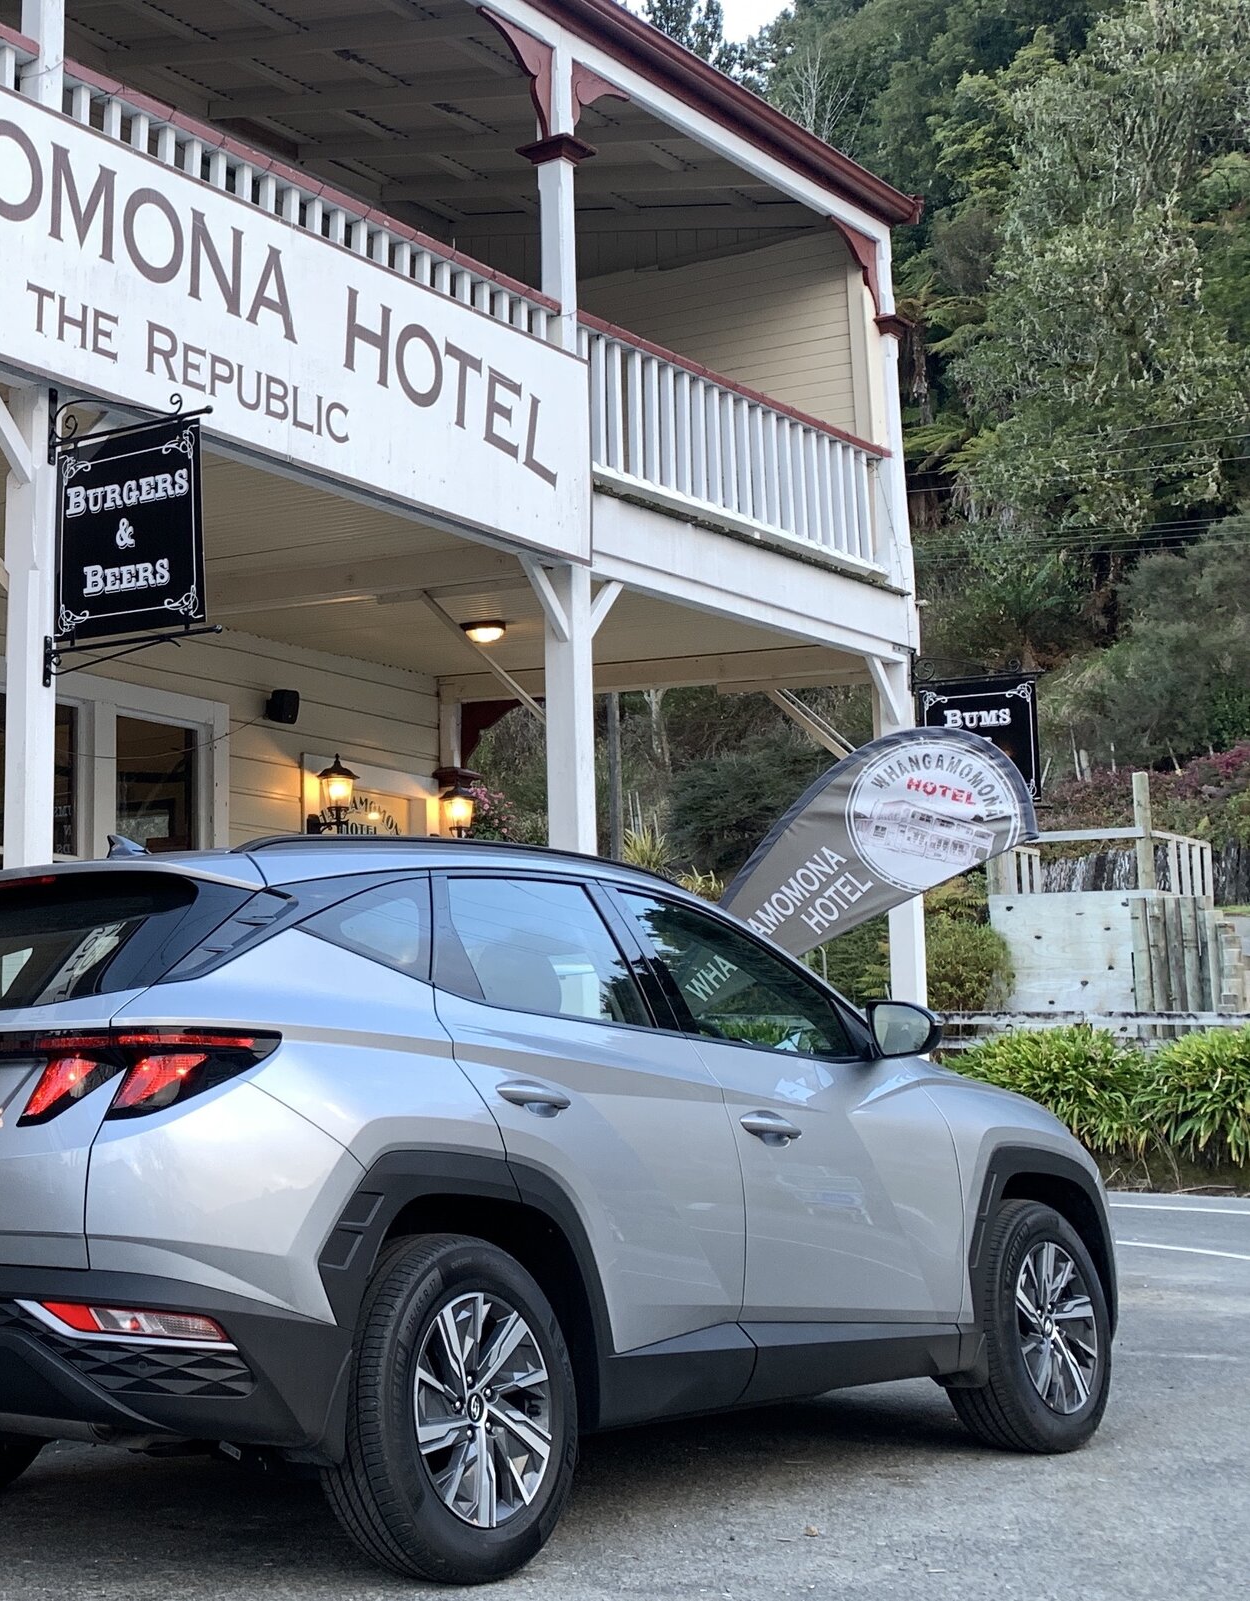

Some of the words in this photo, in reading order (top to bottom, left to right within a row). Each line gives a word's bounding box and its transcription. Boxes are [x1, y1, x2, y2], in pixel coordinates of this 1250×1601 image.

[26, 281, 119, 362] THE
[146, 321, 350, 442] REPUBLIC
[344, 286, 558, 490] HOTEL
[65, 467, 189, 518] BURGERS
[116, 518, 136, 550] &
[83, 557, 171, 597] BEERS
[944, 707, 1012, 729] BUMS
[871, 753, 1006, 820] WHANGAMOMONA
[905, 776, 977, 806] HOTEL
[799, 871, 873, 935] HOTEL
